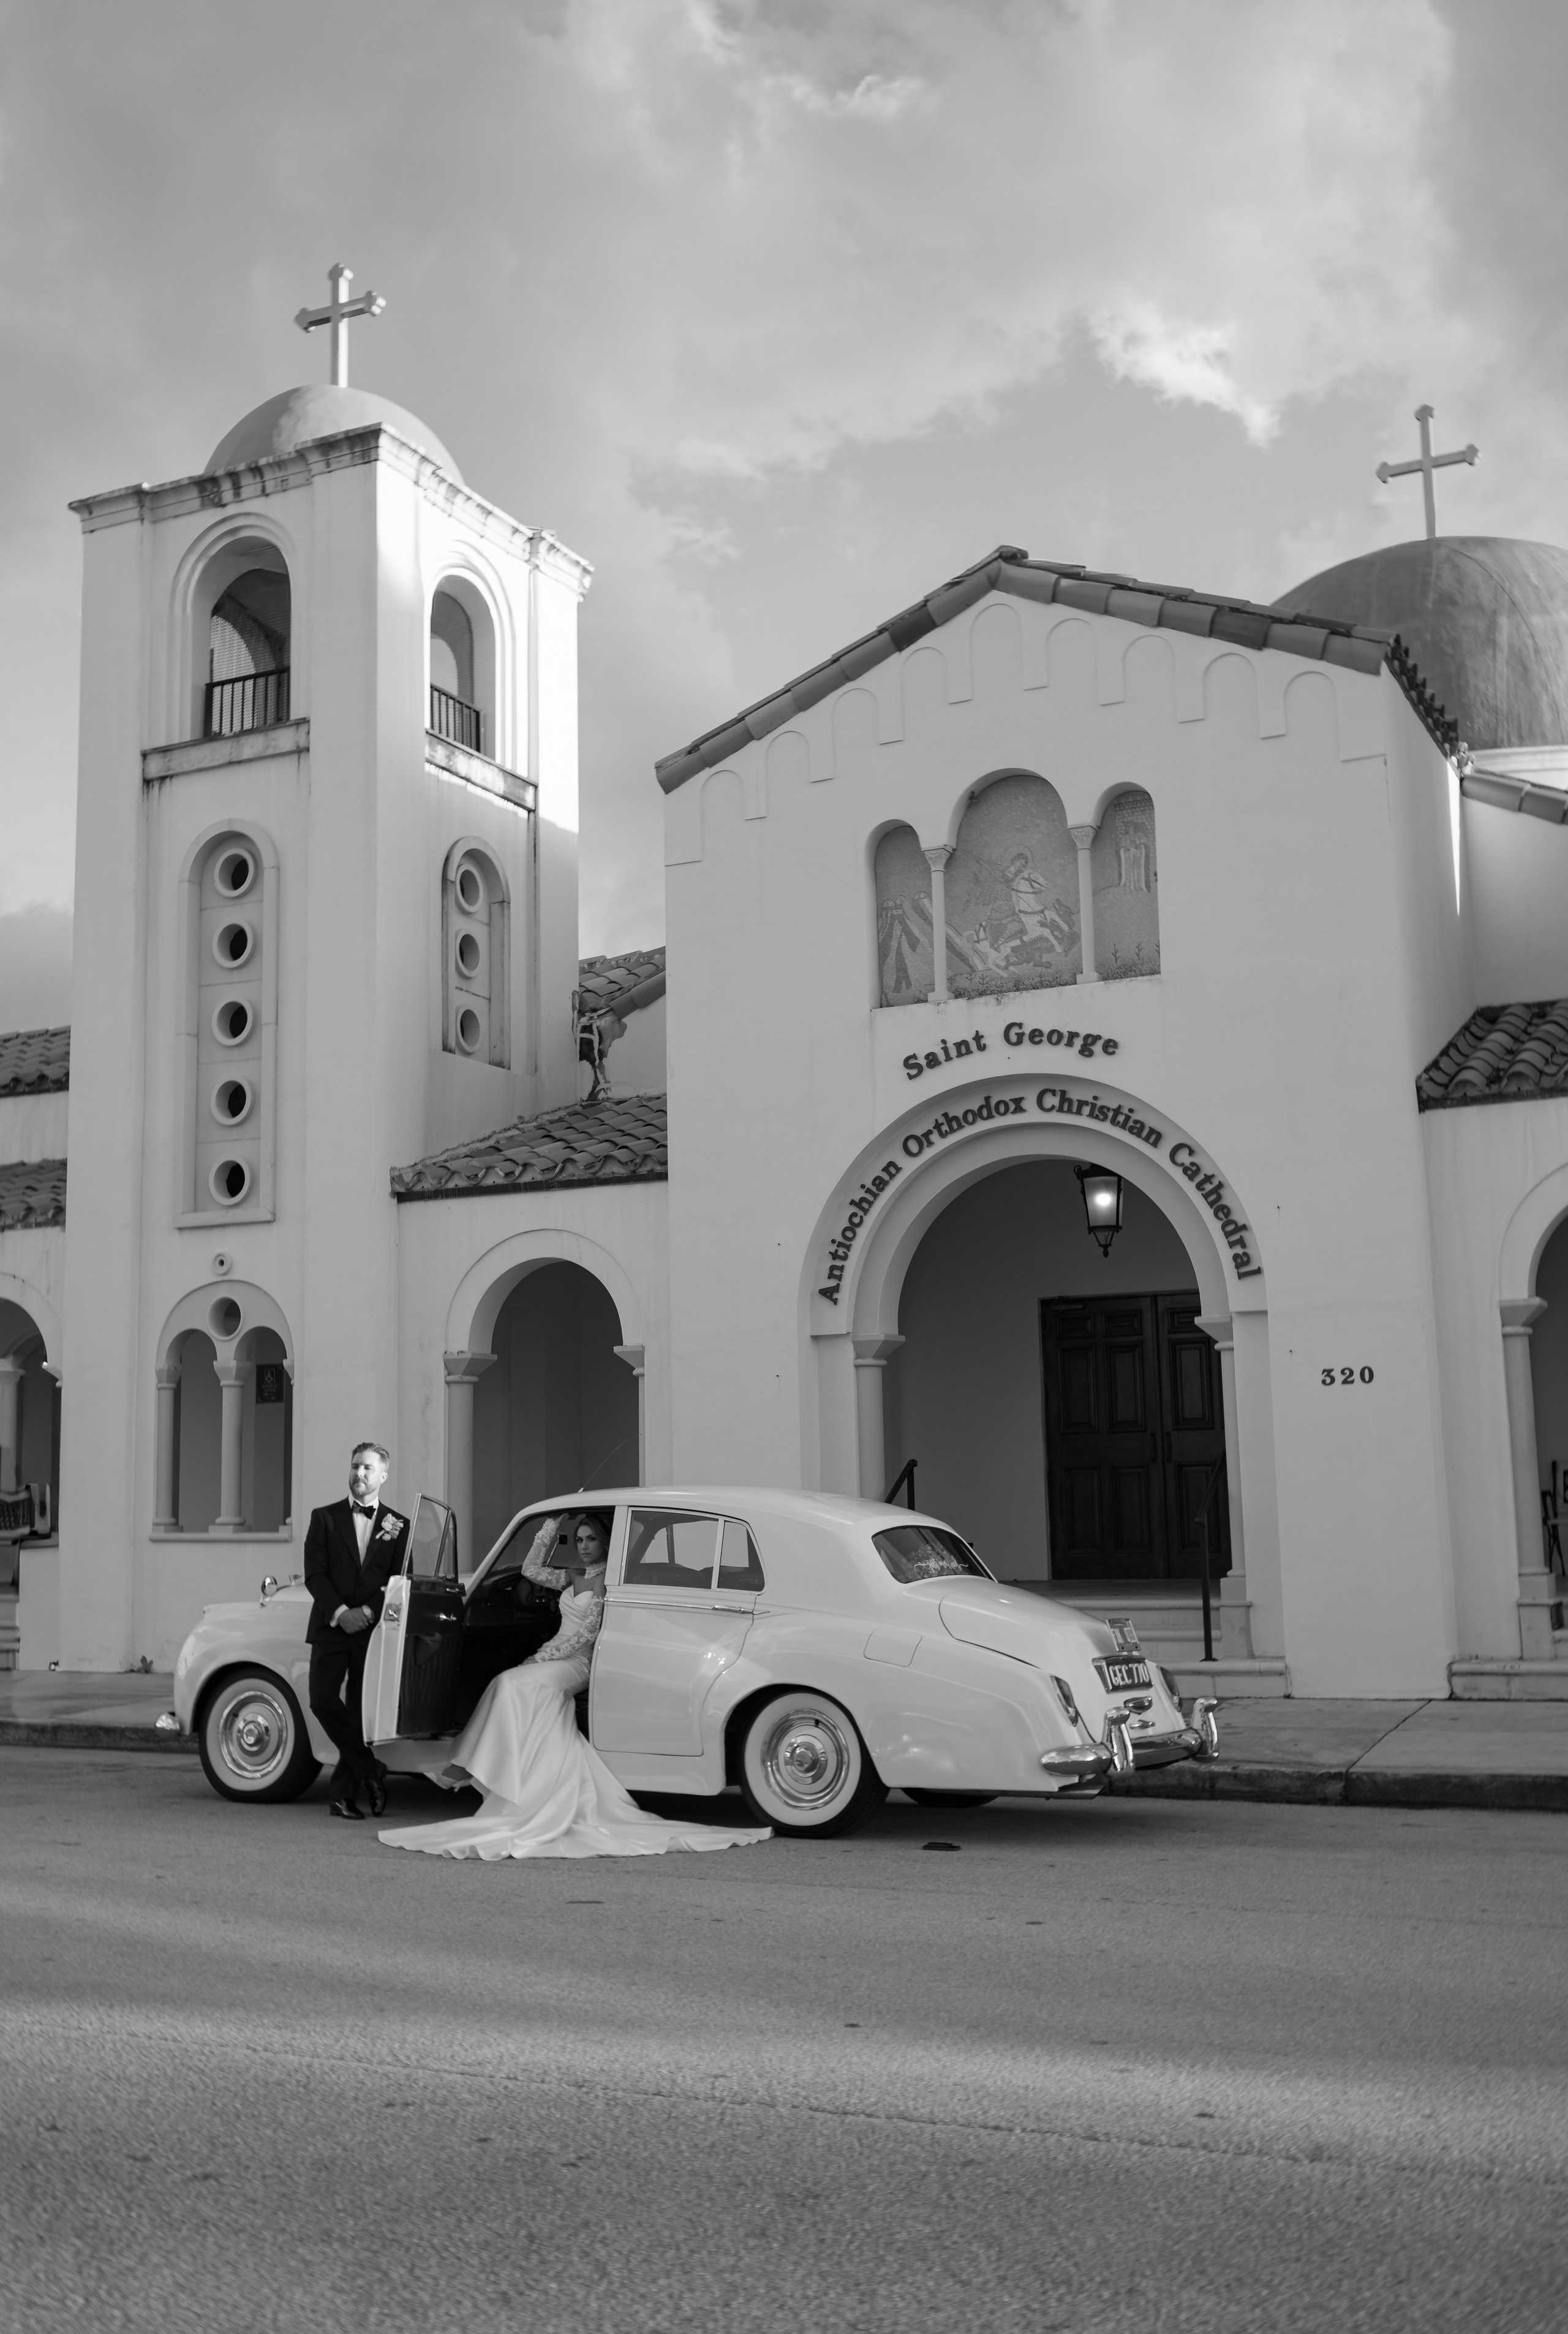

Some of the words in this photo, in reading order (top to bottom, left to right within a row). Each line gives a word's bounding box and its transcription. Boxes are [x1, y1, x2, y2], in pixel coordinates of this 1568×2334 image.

[902, 1030, 987, 1081] Saint
[1003, 1022, 1120, 1059] George
[818, 1160, 903, 1306] Antiochian
[902, 1095, 1027, 1158] Orthodox
[1036, 1087, 1163, 1149] Christian
[1169, 1142, 1262, 1280] Cathedral
[1321, 1365, 1374, 1386] 320
